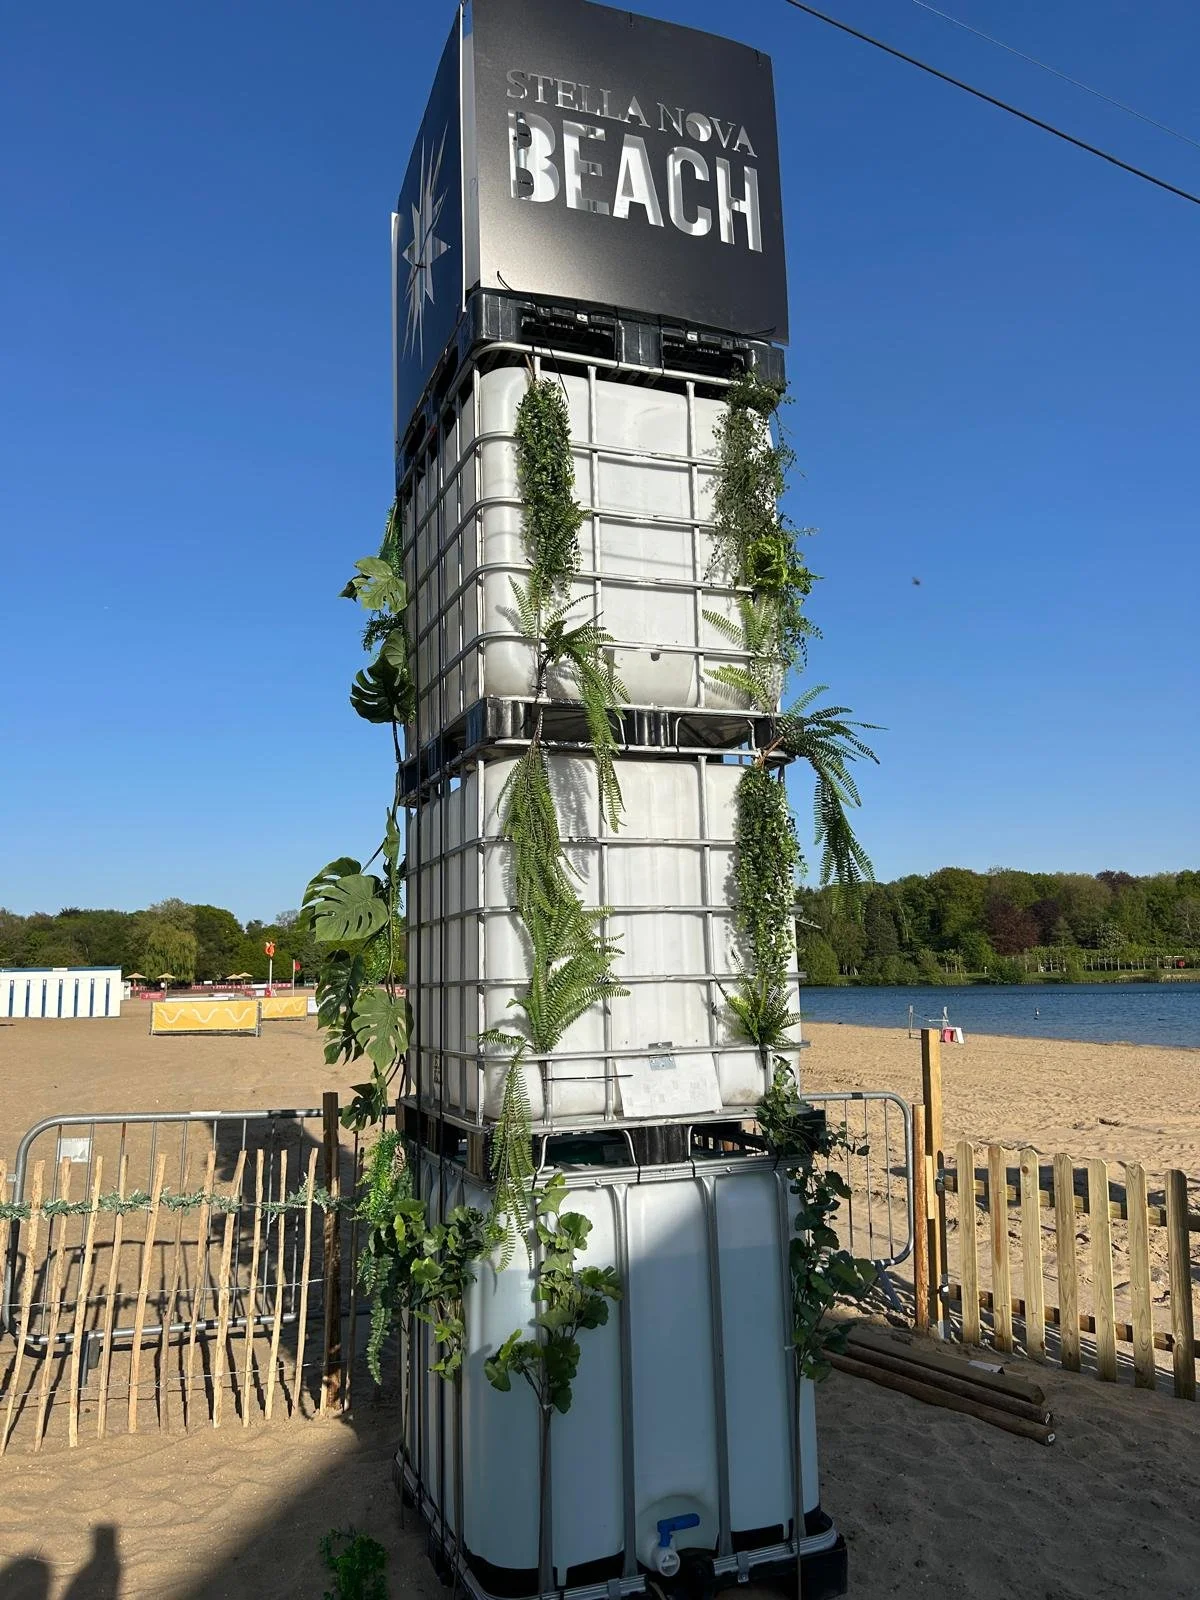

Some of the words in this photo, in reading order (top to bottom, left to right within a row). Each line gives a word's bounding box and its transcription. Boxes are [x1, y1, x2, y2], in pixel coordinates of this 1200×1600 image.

[506, 70, 651, 128] STELLA
[657, 103, 758, 158] NOVA
[508, 110, 762, 252] BEACH
